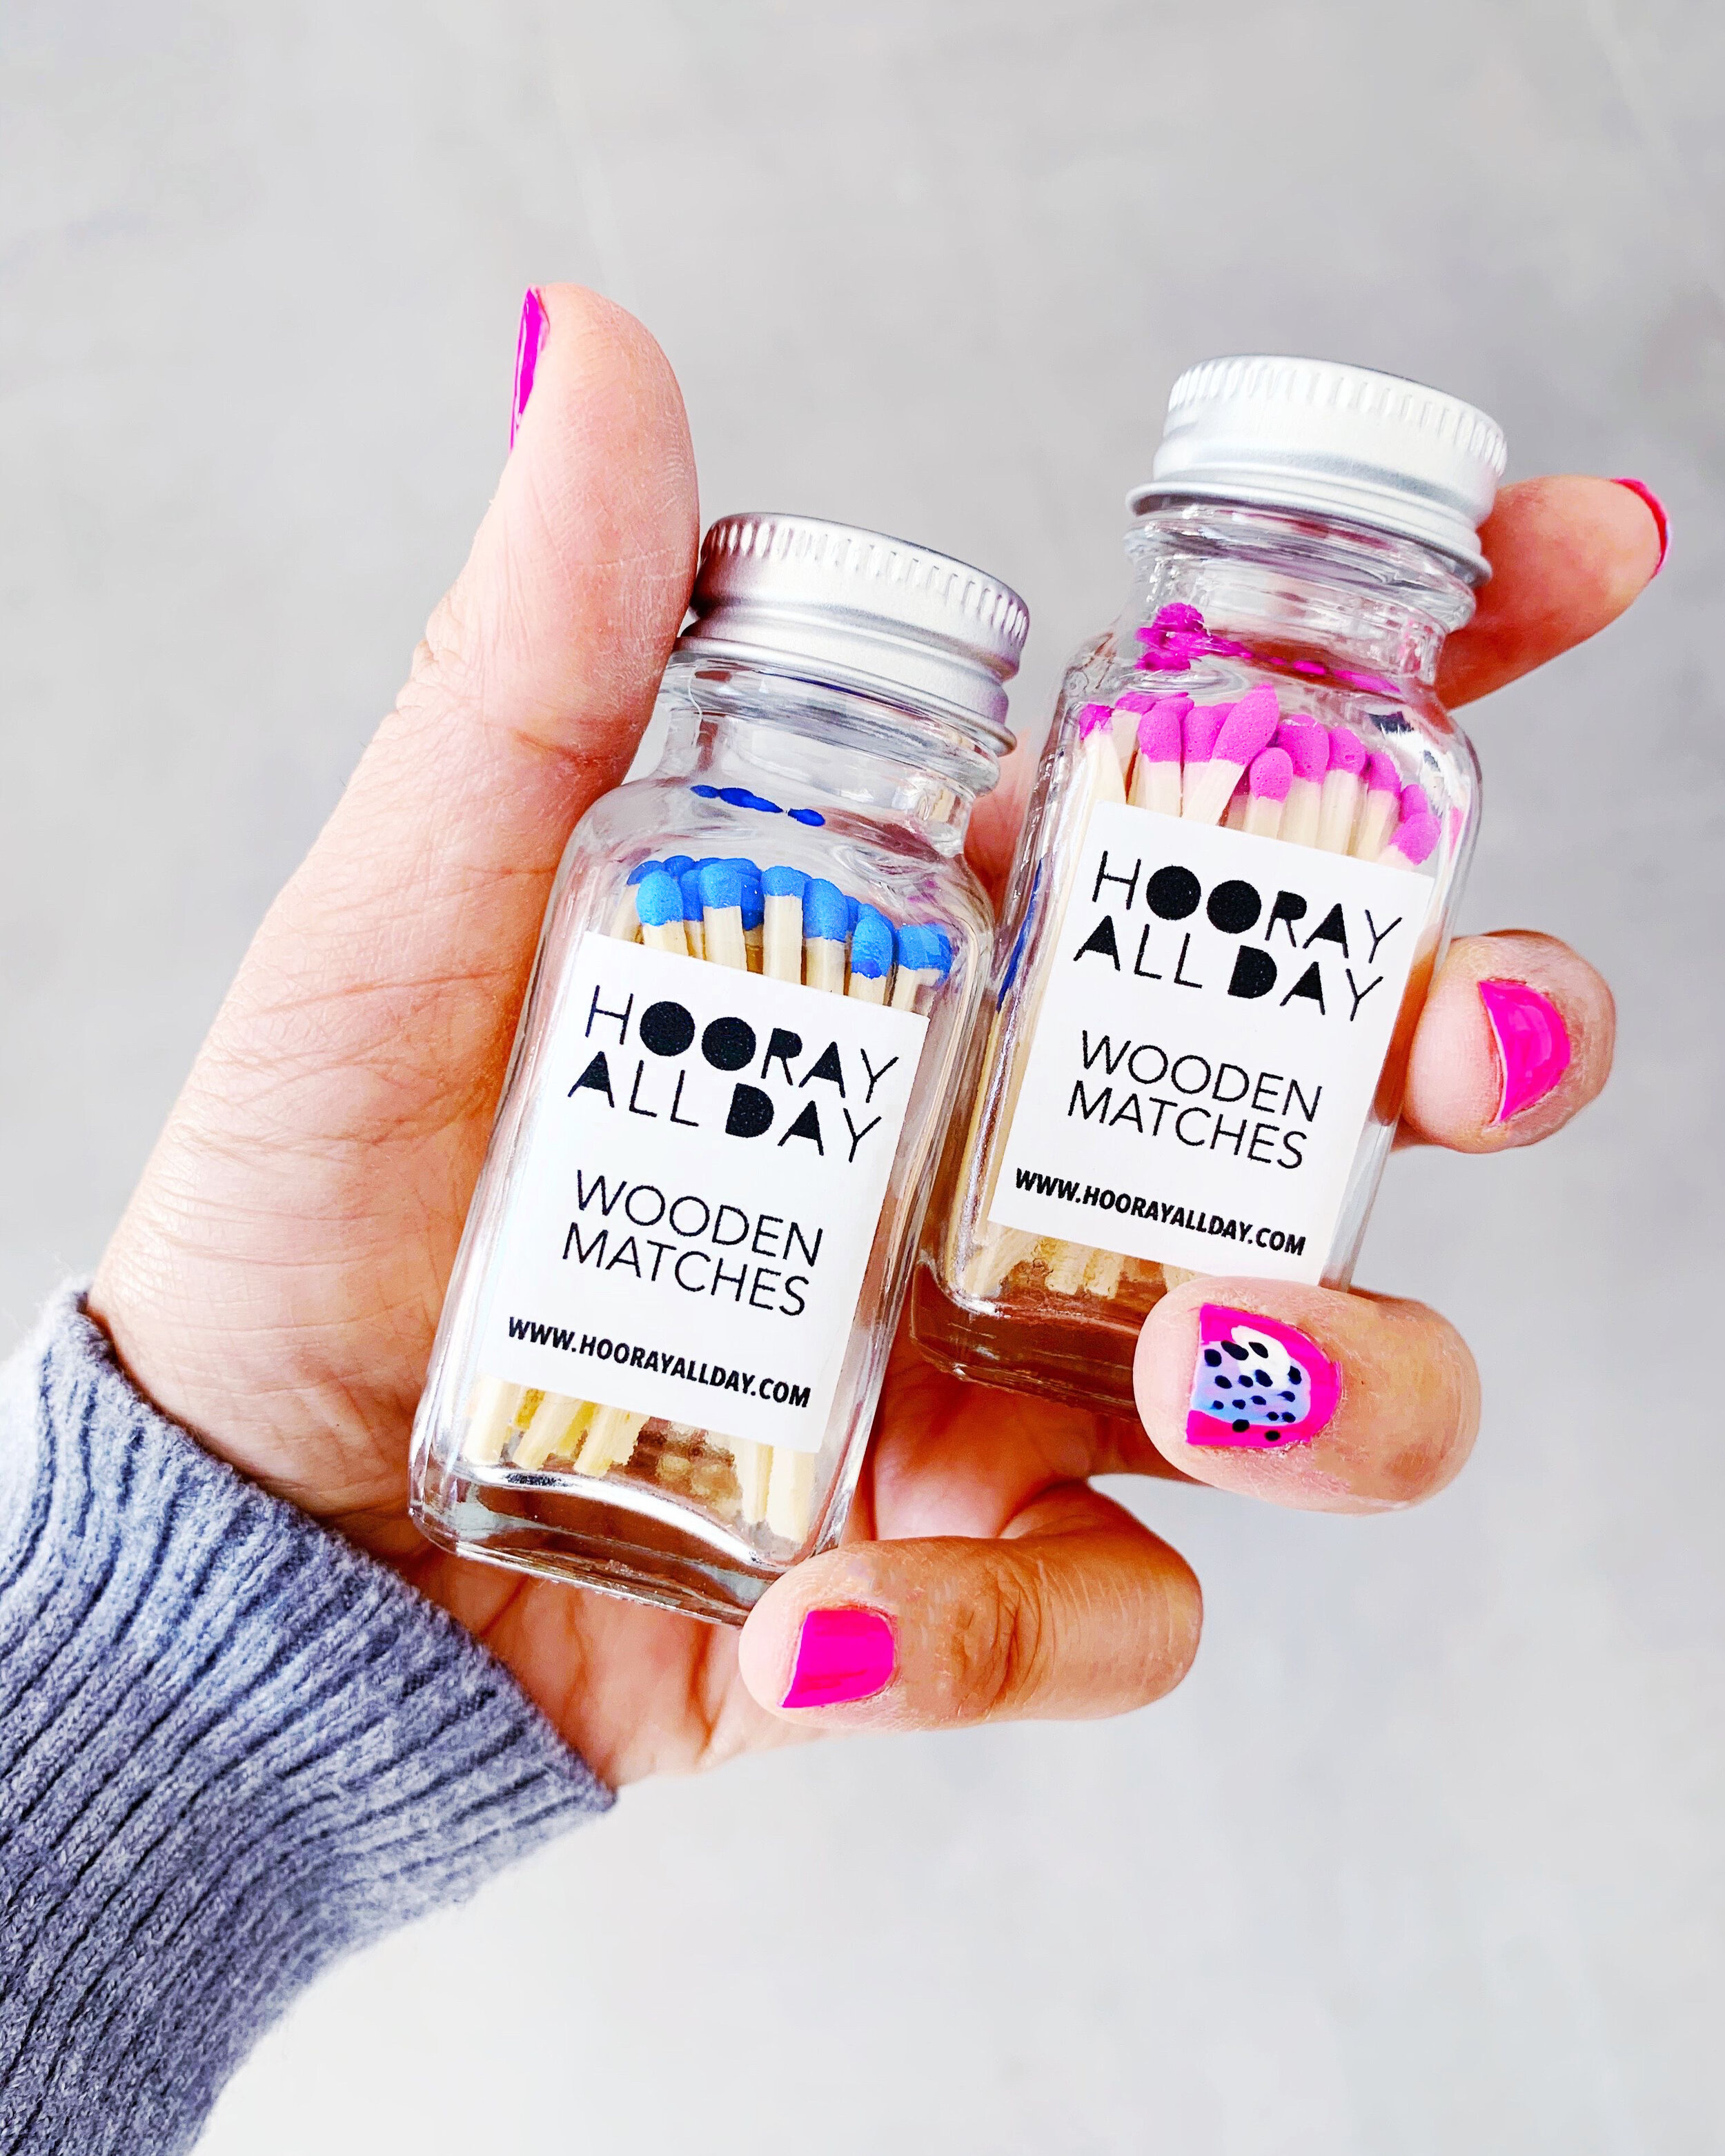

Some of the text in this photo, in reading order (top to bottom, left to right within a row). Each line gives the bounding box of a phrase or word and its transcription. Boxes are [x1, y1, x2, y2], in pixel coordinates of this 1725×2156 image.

[1092, 850, 1403, 964] HOORAY
[1073, 915, 1384, 1022] ALL DAY
[584, 985, 899, 1104] HOORAY
[1082, 1029, 1323, 1122] WOODEN
[567, 1051, 883, 1163] ALL DAY
[1067, 1080, 1308, 1169] MATCHES
[577, 1169, 823, 1267] WOODEN
[1016, 1167, 1306, 1256] WWW.HOORAYALLDAY.COM
[562, 1222, 809, 1316] MATCHES
[509, 1316, 811, 1408] WWW.HOORAYALLDAY.COM
